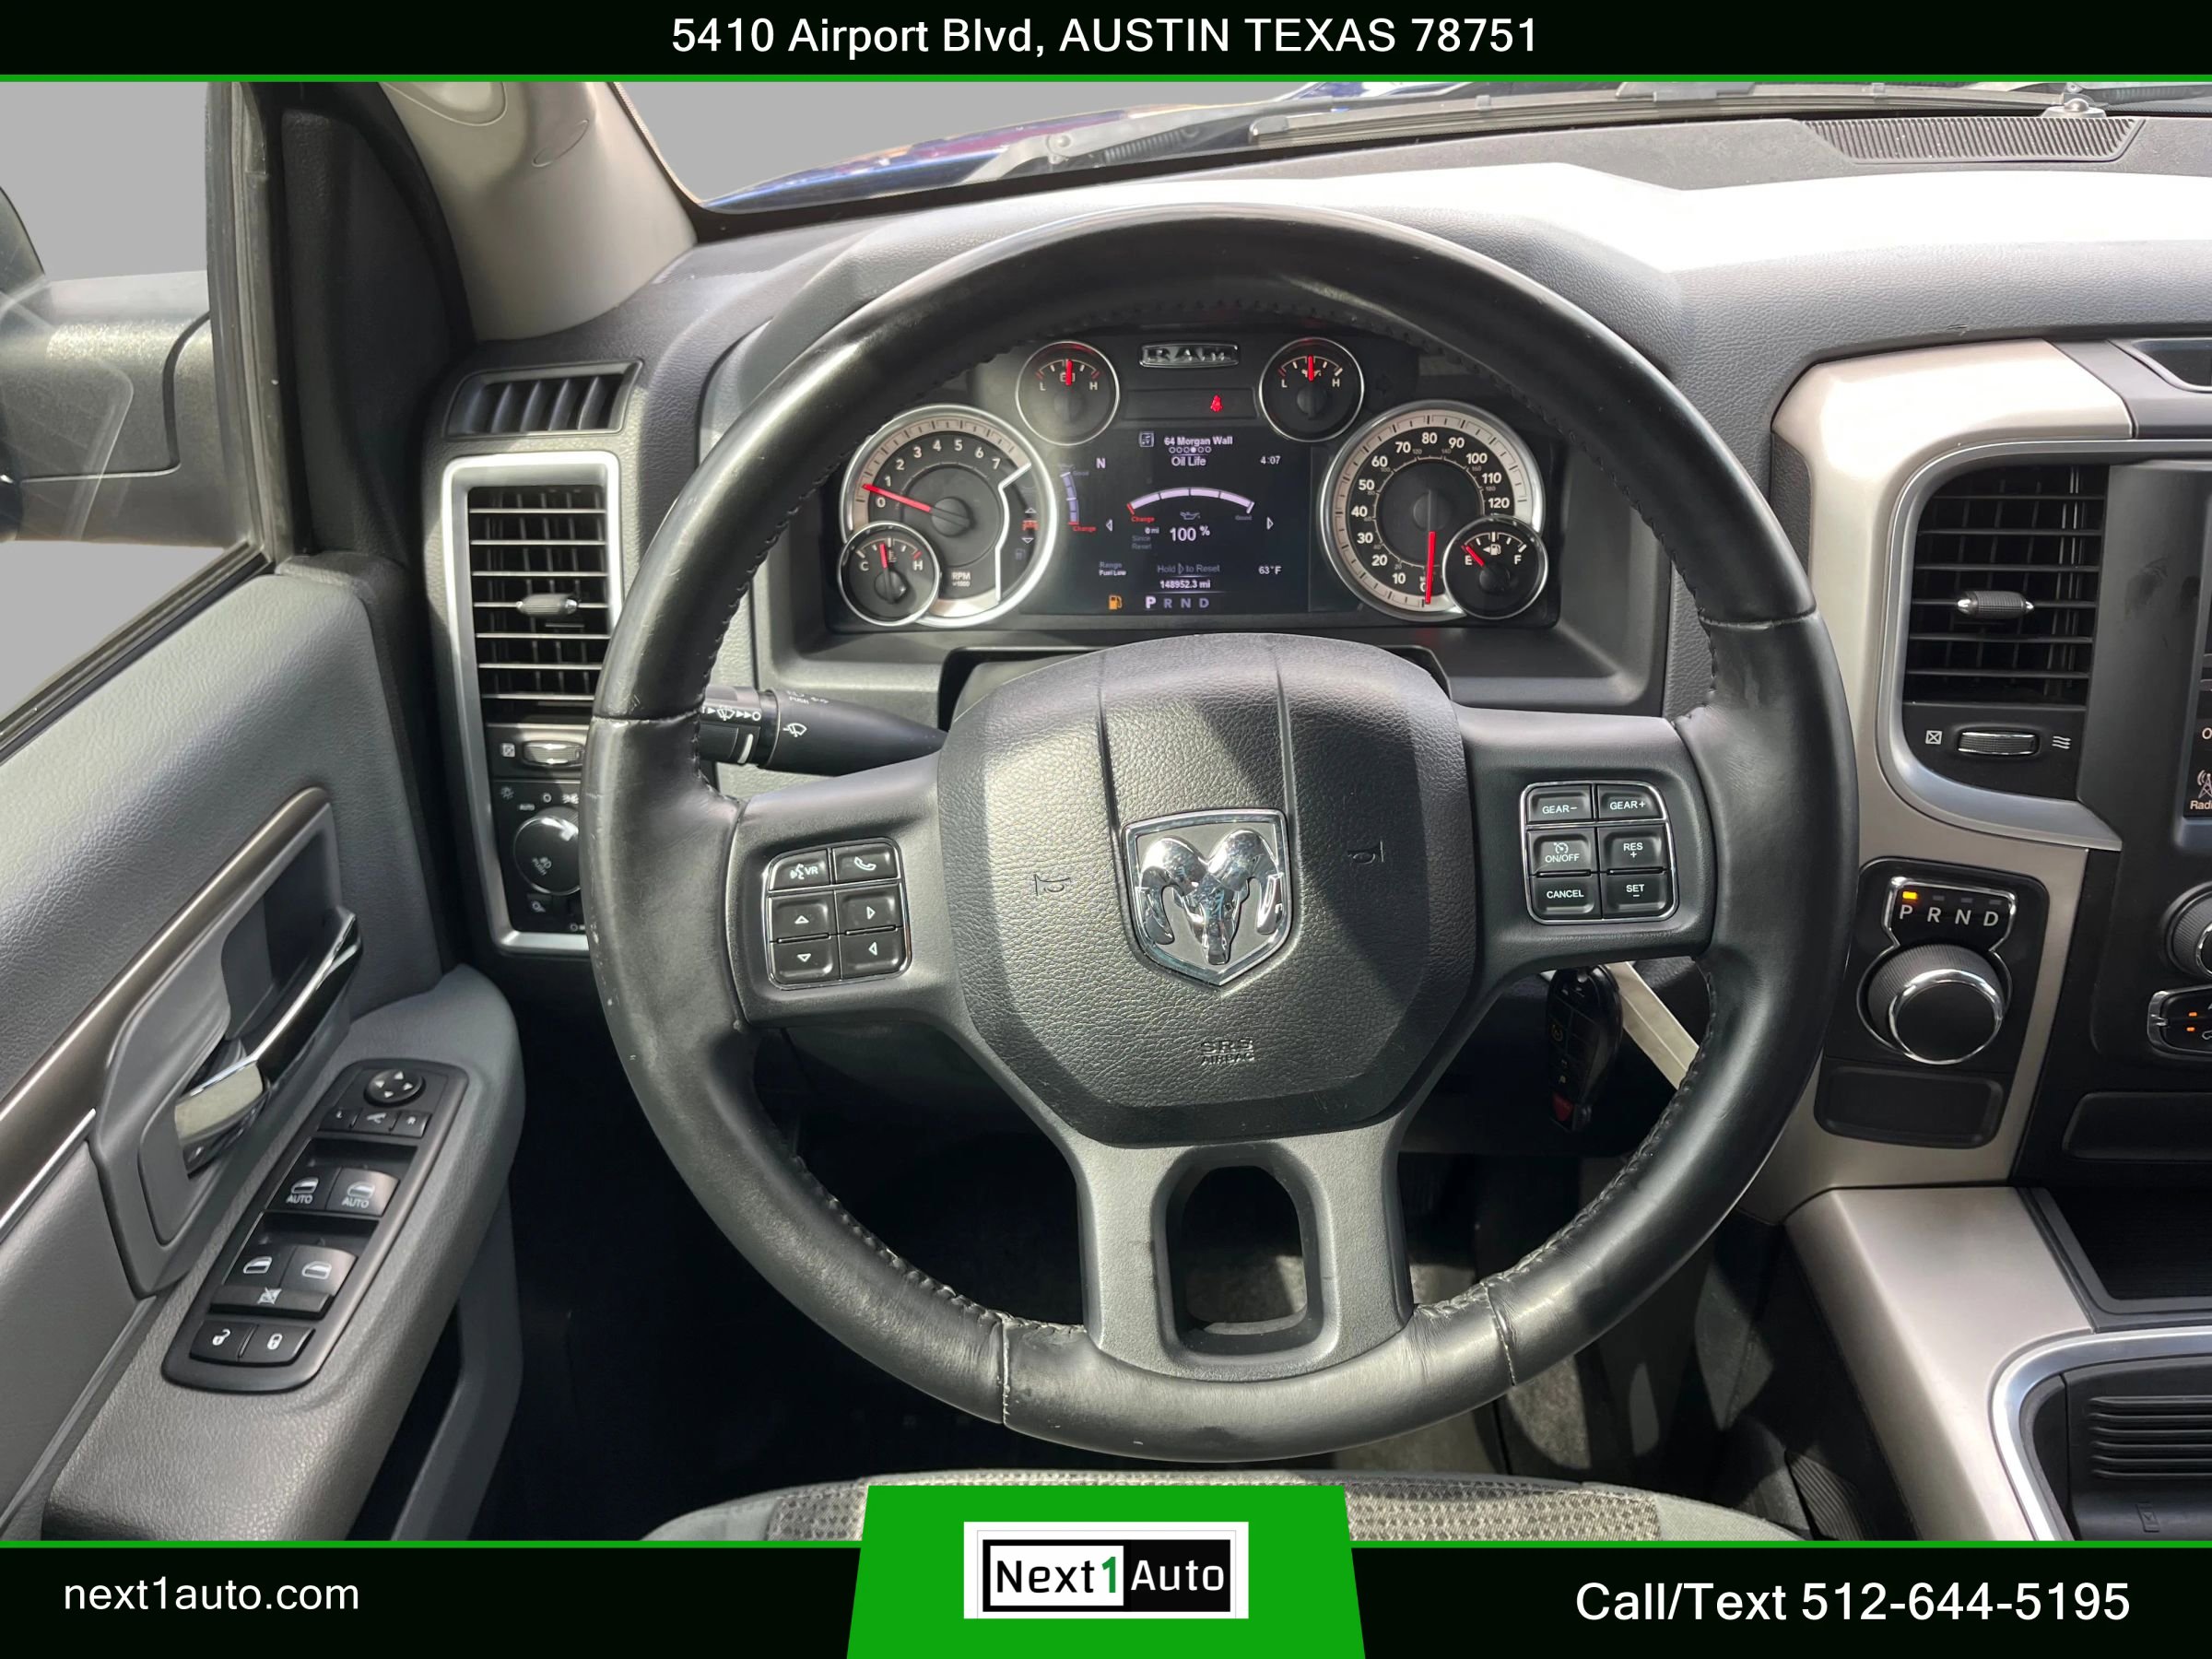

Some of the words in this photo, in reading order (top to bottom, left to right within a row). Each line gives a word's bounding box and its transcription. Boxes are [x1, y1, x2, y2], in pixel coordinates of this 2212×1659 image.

[1143, 345, 1233, 364] RAM
[1039, 382, 1047, 392] L
[1088, 382, 1099, 392] H
[1281, 380, 1288, 389] L
[1332, 378, 1341, 388] H
[1164, 436, 1175, 446] 64
[1176, 436, 1211, 448] Morgan
[1212, 435, 1234, 446] Wall
[1421, 431, 1438, 444] 80
[1448, 437, 1465, 449] 90
[933, 440, 942, 452] 4
[954, 440, 963, 452] 5
[1394, 441, 1412, 453] 70
[913, 447, 923, 458] 3
[975, 447, 984, 458] 6
[992, 458, 1001, 470] 7
[1096, 458, 1106, 468] N
[1171, 456, 1186, 467] Oil
[1187, 456, 1207, 467] Life
[1260, 455, 1281, 465] 4:07
[1371, 455, 1389, 467] 60
[1465, 452, 1488, 465] 100
[896, 459, 905, 471] 2
[885, 476, 892, 487] 1
[1481, 471, 1502, 484] 110
[1358, 479, 1375, 491] 50
[877, 498, 886, 508] 0
[1488, 497, 1511, 509] 120
[1350, 504, 1369, 517] 40
[1170, 526, 1197, 542] 100
[1357, 532, 1374, 545] 30
[1099, 561, 1123, 570] Range
[1371, 553, 1388, 567] 20
[1465, 556, 1473, 565] E
[1514, 556, 1522, 565] F
[860, 561, 869, 571] C
[913, 561, 923, 571] H
[1157, 565, 1176, 573] Hold
[1196, 564, 1220, 572] Reset
[951, 571, 971, 581] RPM
[1392, 572, 1406, 584] 10
[1159, 580, 1198, 589] 148952.3
[1199, 579, 1211, 589] mi
[1145, 595, 1157, 609] P
[1163, 597, 1173, 608] R
[1181, 597, 1192, 608] N
[1199, 597, 1210, 608] D
[1623, 842, 1644, 852] RES
[1545, 853, 1581, 864] ON/OFF
[804, 865, 818, 876] VR
[1546, 889, 1584, 899] CANCEL
[1626, 884, 1645, 893] SET
[1899, 904, 1913, 920] P
[1926, 906, 1942, 924] R
[1955, 909, 1972, 925] N
[1983, 911, 1999, 927] D
[287, 1194, 313, 1204] AUTO
[342, 1197, 370, 1208] AUTO
